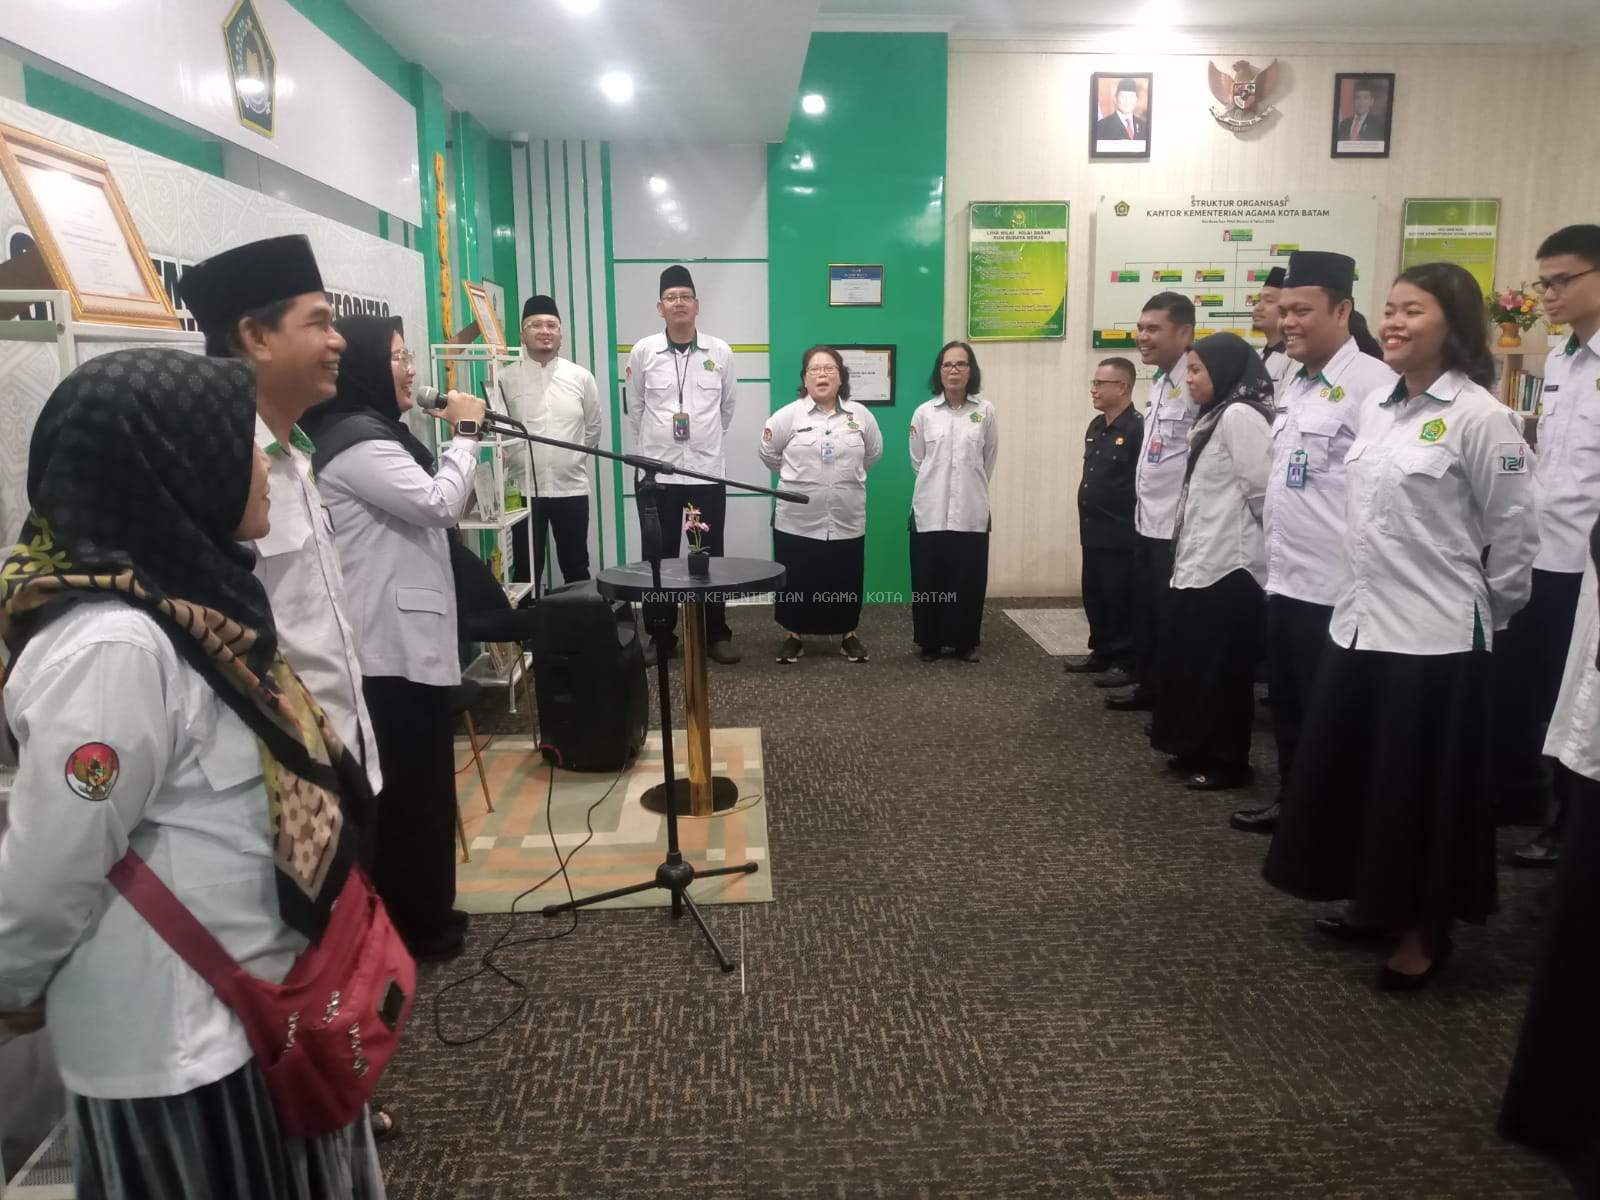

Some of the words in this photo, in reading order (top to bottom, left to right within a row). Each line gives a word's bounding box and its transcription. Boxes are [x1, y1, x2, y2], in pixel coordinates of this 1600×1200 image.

[1190, 199, 1234, 207] STRUKTUR
[1236, 199, 1287, 207] ORGANISASI
[1146, 209, 1181, 217] KANTOR
[1183, 209, 1244, 217] KEMENTERIAN
[1245, 209, 1276, 217] AGAMA
[1278, 209, 1300, 217] KOTA
[1301, 209, 1330, 217] BATAM
